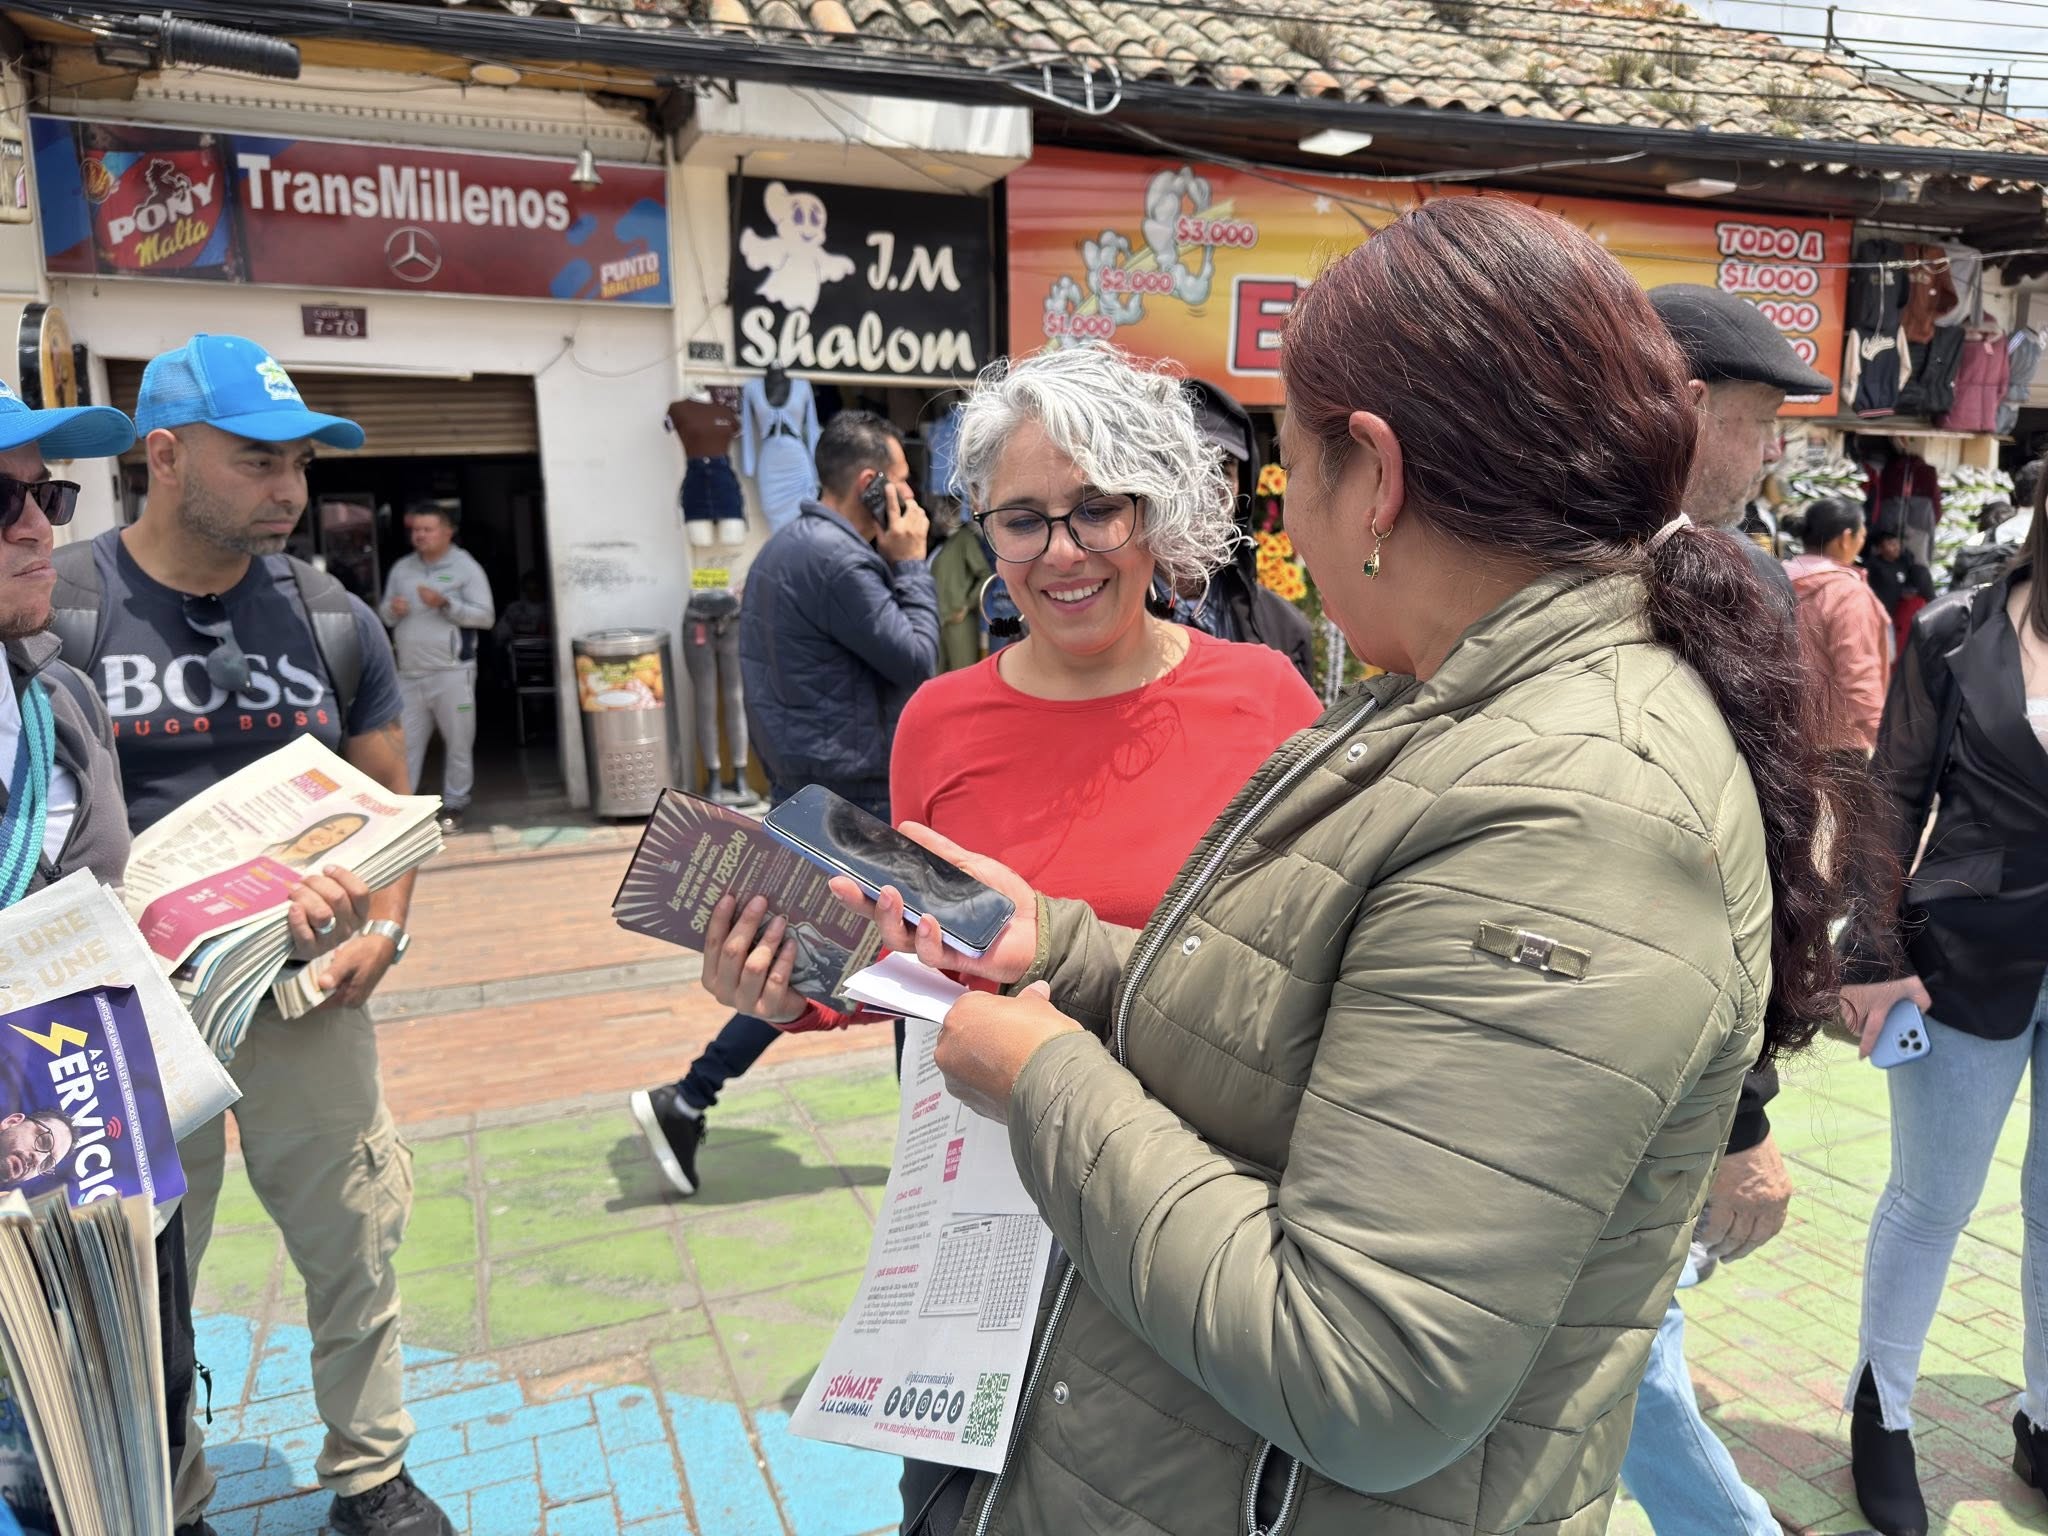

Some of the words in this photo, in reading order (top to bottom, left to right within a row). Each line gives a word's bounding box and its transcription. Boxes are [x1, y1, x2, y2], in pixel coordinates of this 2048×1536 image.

[237, 153, 570, 231] TransMillenos
[108, 173, 216, 245] PONY
[135, 217, 209, 268] Malta
[1176, 217, 1256, 247] $3.000
[1719, 225, 1798, 257] TODO
[1800, 232, 1823, 259] A
[600, 251, 659, 285] PUNTO
[866, 231, 961, 292] J.M
[1100, 267, 1175, 294] $2.000
[1720, 261, 1816, 295] $1.000
[740, 306, 977, 374] Shalom
[1045, 313, 1115, 338] $1.000
[1232, 279, 1290, 372] E
[101, 654, 326, 717] BOSS
[239, 709, 329, 731] BOSS
[711, 829, 749, 885] DERECHO
[702, 882, 722, 906] UN
[17, 907, 91, 956] UNE
[690, 904, 712, 933] SON
[37, 937, 110, 988] UNE
[97, 996, 111, 1021] JUNTOS
[104, 1020, 115, 1035] POR
[109, 1034, 120, 1048] UNA
[88, 1049, 103, 1060] A
[113, 1048, 125, 1069] NUEVA
[93, 1061, 110, 1081] SU
[118, 1068, 128, 1081] LEY
[121, 1080, 130, 1090] DE
[123, 1089, 137, 1121] SERVICIOS
[136, 1150, 148, 1167] PARA
[140, 1166, 149, 1177] LA
[141, 1176, 154, 1196] GENT
[820, 1369, 883, 1402] ¡SÚMATE
[819, 1400, 827, 1411] A
[825, 1400, 837, 1412] LA
[835, 1400, 873, 1417] CAMPAÑA!
